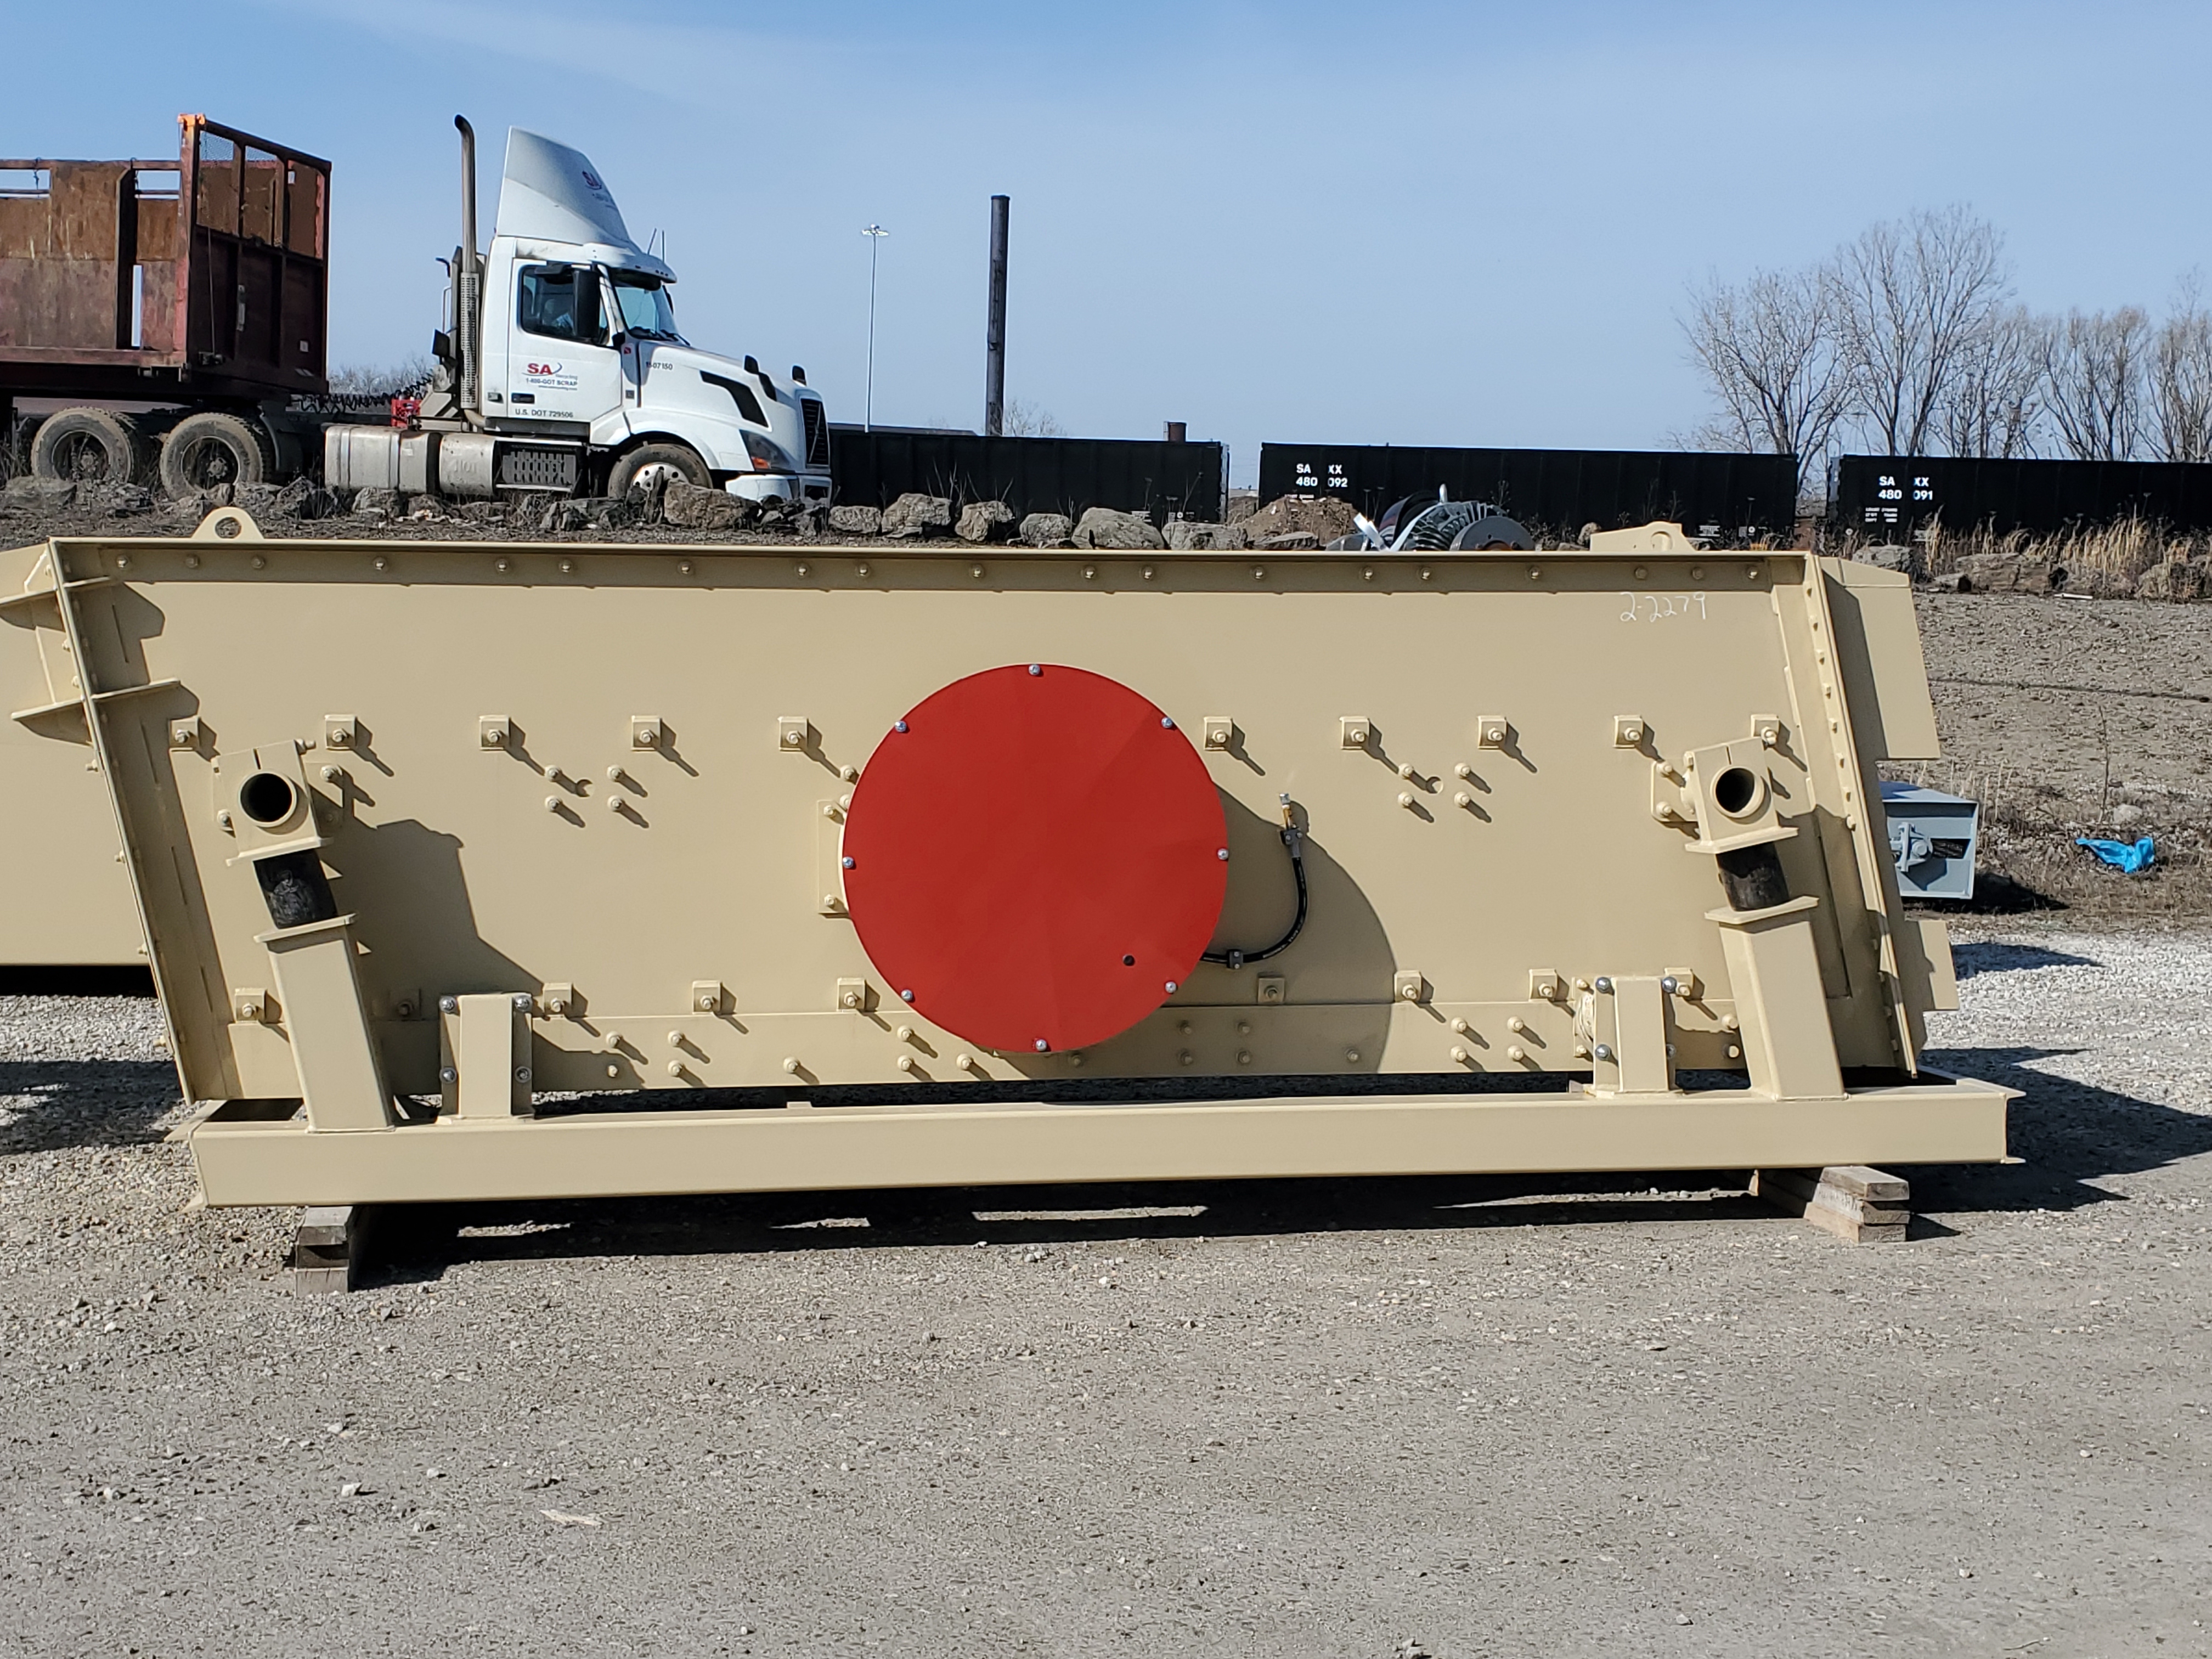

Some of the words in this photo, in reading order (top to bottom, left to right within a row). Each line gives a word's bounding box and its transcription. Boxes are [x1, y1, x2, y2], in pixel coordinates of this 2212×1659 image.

[527, 363, 553, 375] SA
[1296, 464, 1311, 473] SA
[1328, 464, 1342, 475] XX
[1296, 477, 1318, 487] 480
[1327, 477, 1348, 488] 092
[1879, 476, 1895, 486] SA
[1914, 477, 1929, 487] XX
[1878, 489, 1903, 499] 480
[1913, 490, 1933, 500] 091
[1620, 591, 1706, 623] 2-2279
